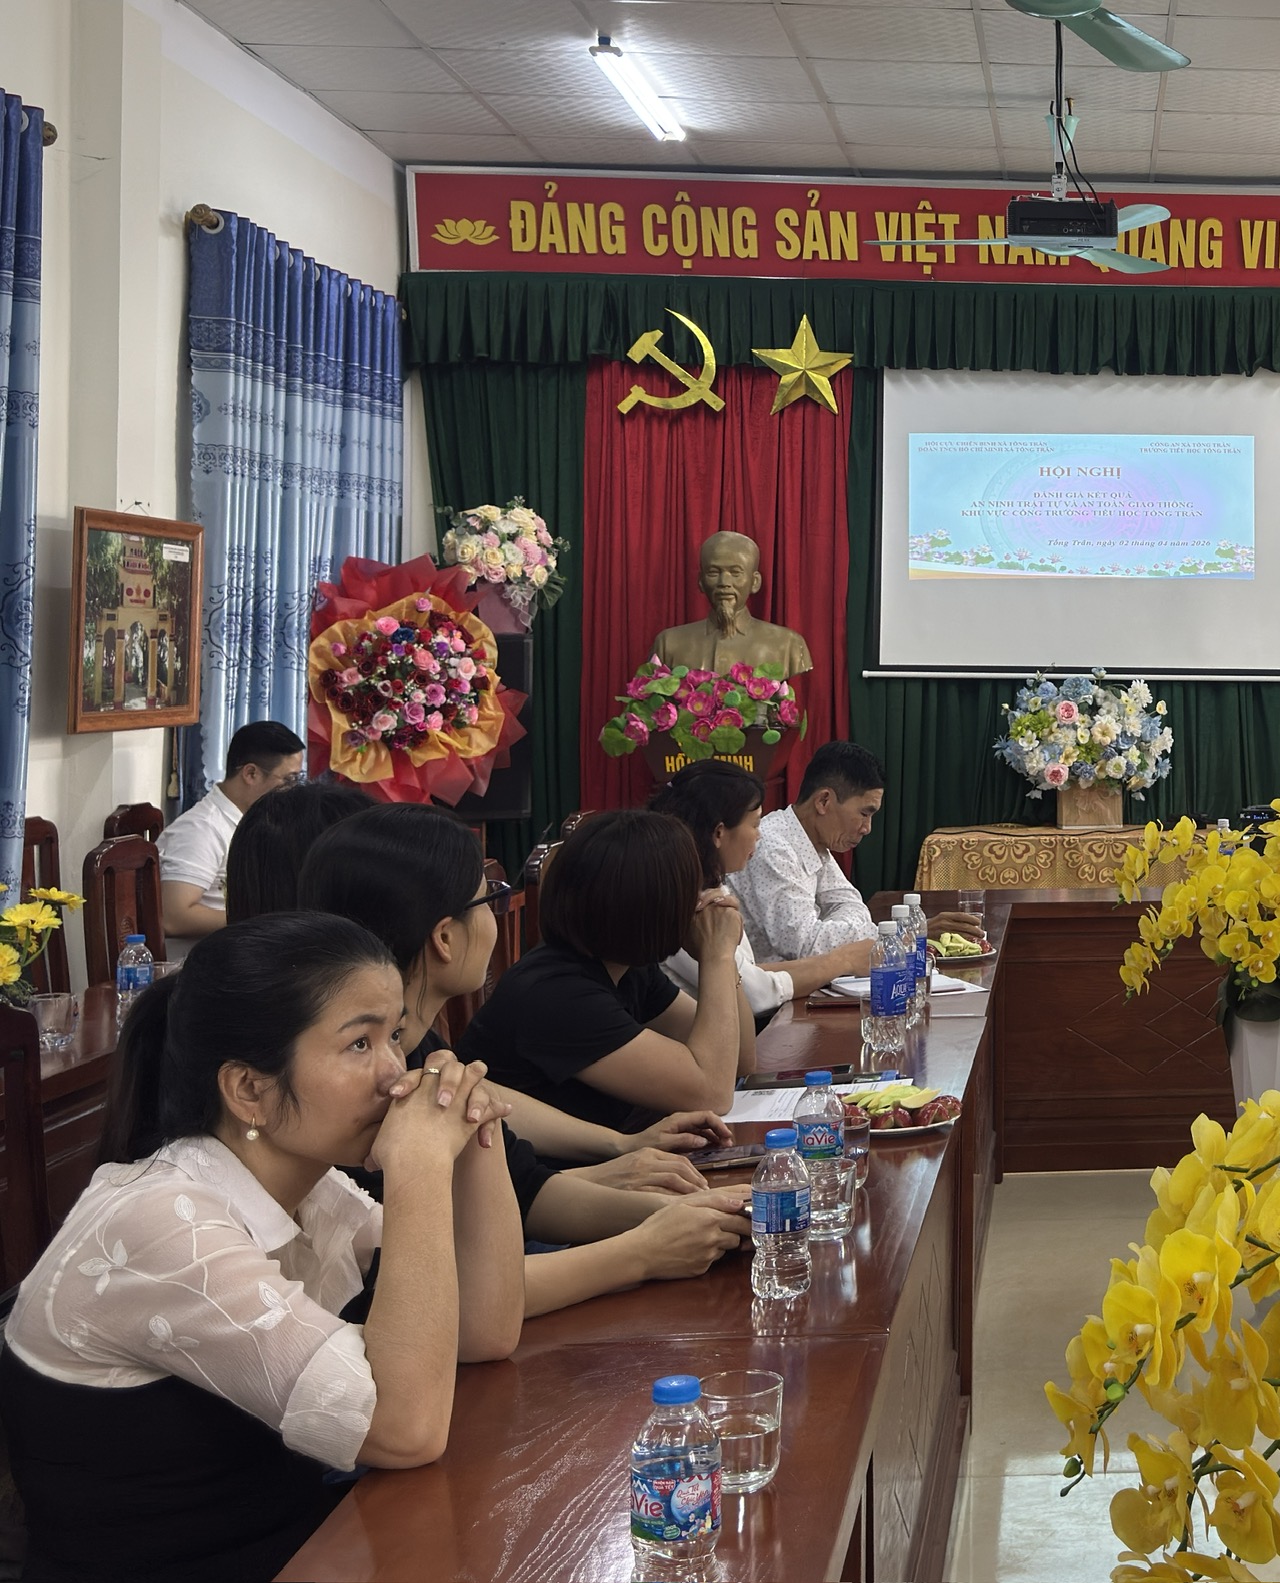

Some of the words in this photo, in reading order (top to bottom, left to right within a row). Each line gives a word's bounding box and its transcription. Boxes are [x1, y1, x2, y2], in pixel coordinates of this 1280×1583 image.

[508, 181, 627, 256] ĐẢNG
[642, 191, 759, 269] CỘNG
[775, 190, 859, 263] SẢN
[874, 201, 961, 275] VIỆT
[1039, 465, 1071, 479] HỘI
[1077, 466, 1121, 479] NGHỊ
[961, 509, 985, 517] KHU
[631, 1490, 664, 1517] Vie
